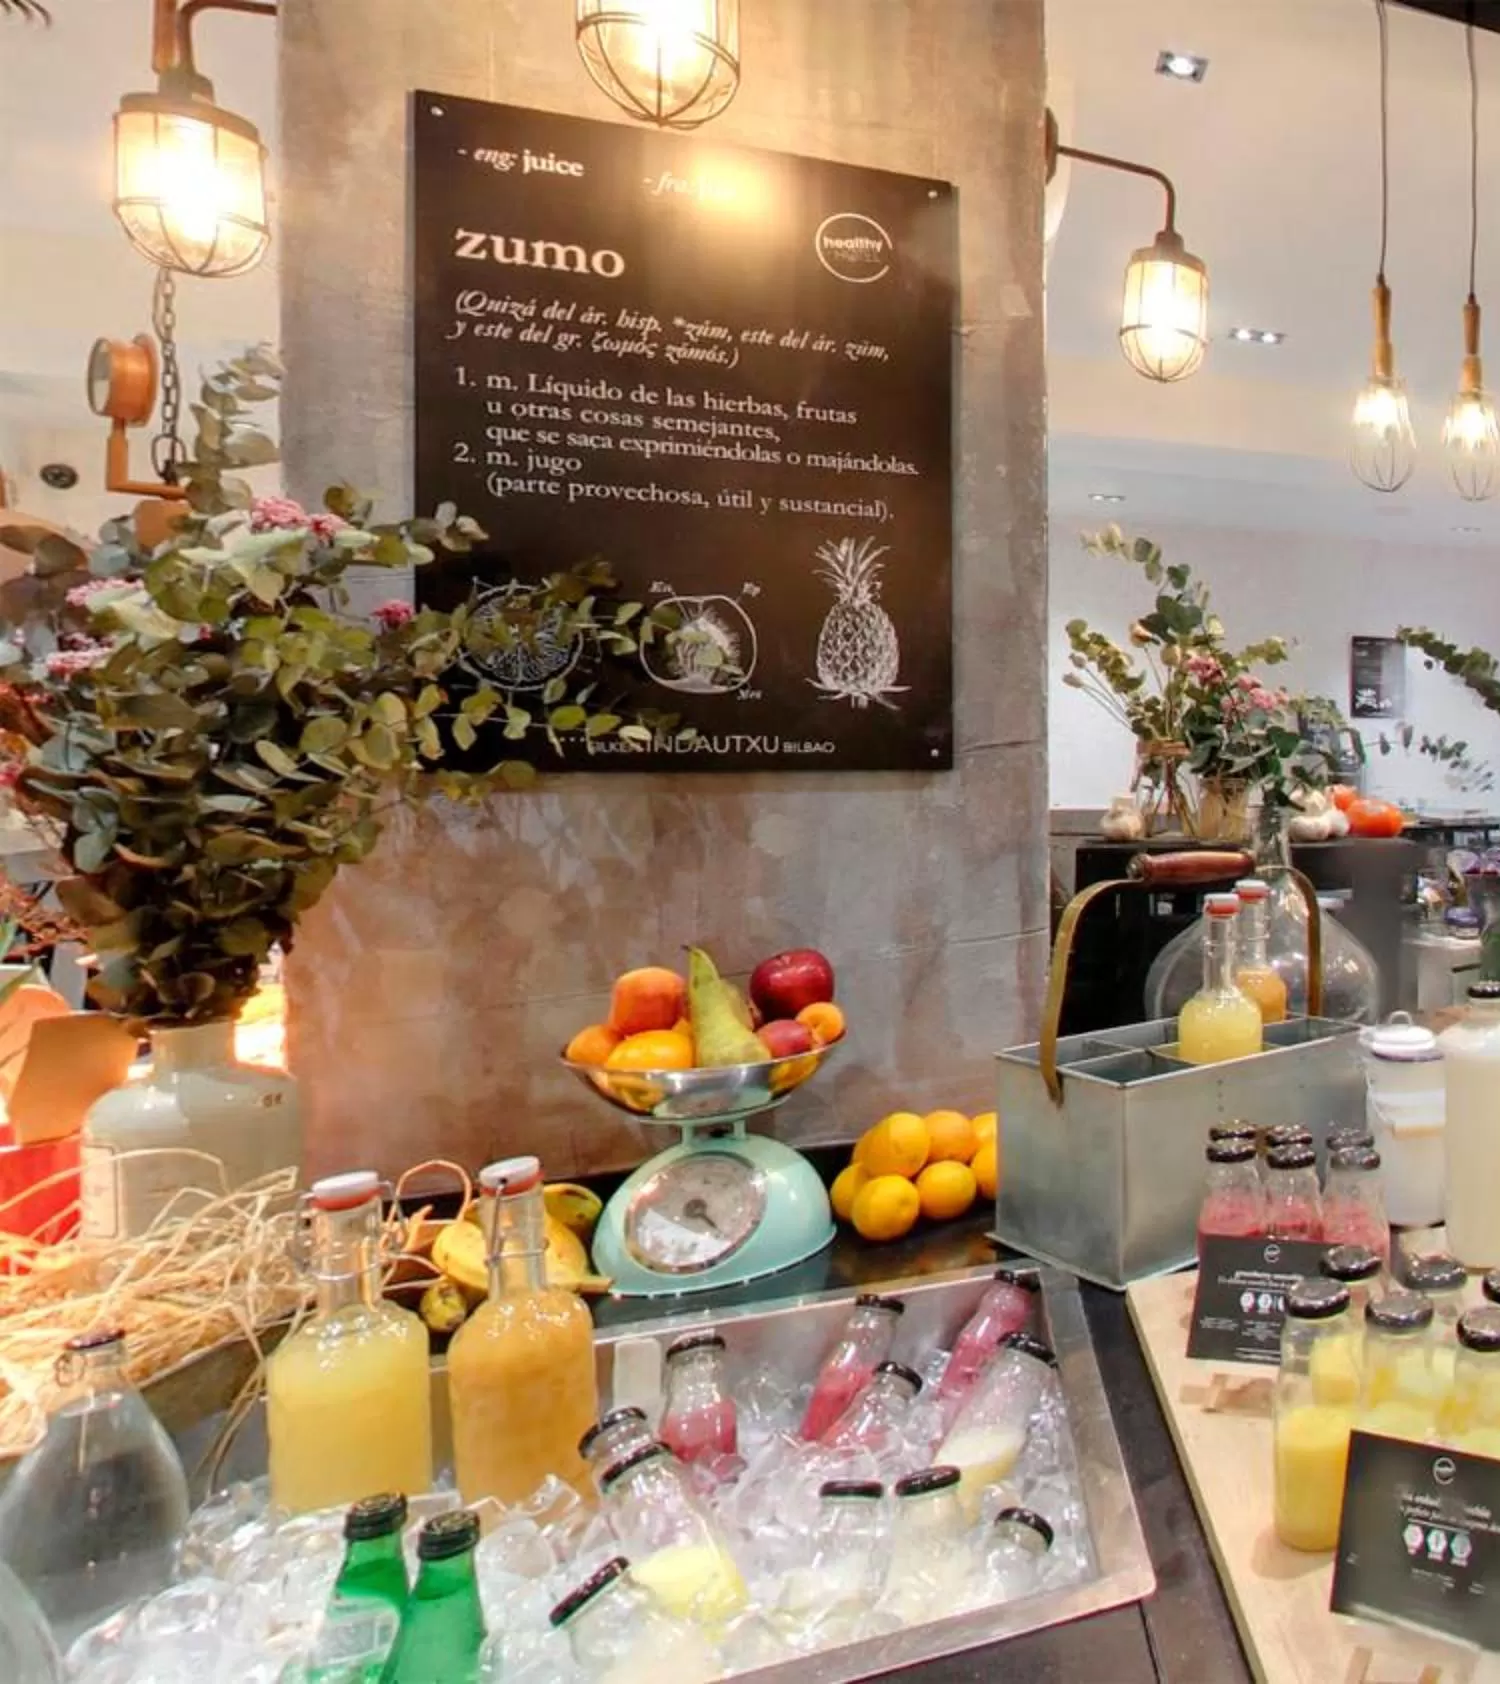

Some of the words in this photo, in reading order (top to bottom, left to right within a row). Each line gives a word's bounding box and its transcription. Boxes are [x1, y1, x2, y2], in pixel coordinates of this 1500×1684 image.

[522, 149, 585, 177] juice
[455, 228, 625, 278] zumo
[823, 236, 883, 252] healthy
[444, 320, 468, 339] y
[473, 323, 513, 339] este
[518, 323, 553, 343] del
[552, 332, 582, 352] gr.
[455, 290, 536, 322] (Quizá
[542, 301, 576, 321] del
[579, 306, 608, 325] ár.
[740, 329, 775, 345] este
[779, 329, 811, 349] del
[812, 335, 837, 353] ár.
[455, 366, 477, 387] 1.
[486, 374, 519, 392] m.
[527, 373, 623, 402] Líquido
[631, 384, 659, 405] de
[666, 388, 696, 408] las
[703, 391, 789, 420] hierbas,
[796, 401, 858, 425] frutas
[486, 401, 503, 415] u
[510, 402, 573, 421] otras
[580, 408, 645, 427] cosas
[652, 414, 781, 443] semejantes,
[453, 442, 477, 463] 2.
[486, 451, 519, 467] m.
[527, 448, 583, 476] jugo
[486, 425, 530, 447] que
[535, 430, 561, 445] se
[567, 432, 613, 449] saca
[619, 437, 781, 464] exprimiéndolas
[787, 450, 801, 465] o
[807, 452, 920, 476] majándolas.
[486, 471, 561, 497] (parte
[568, 483, 710, 508] provechosa,
[717, 488, 753, 508] útil
[759, 498, 772, 514] y
[779, 498, 895, 523] sustancial).
[646, 735, 779, 753] INDAUTXU
[783, 741, 835, 753] BILBAO
